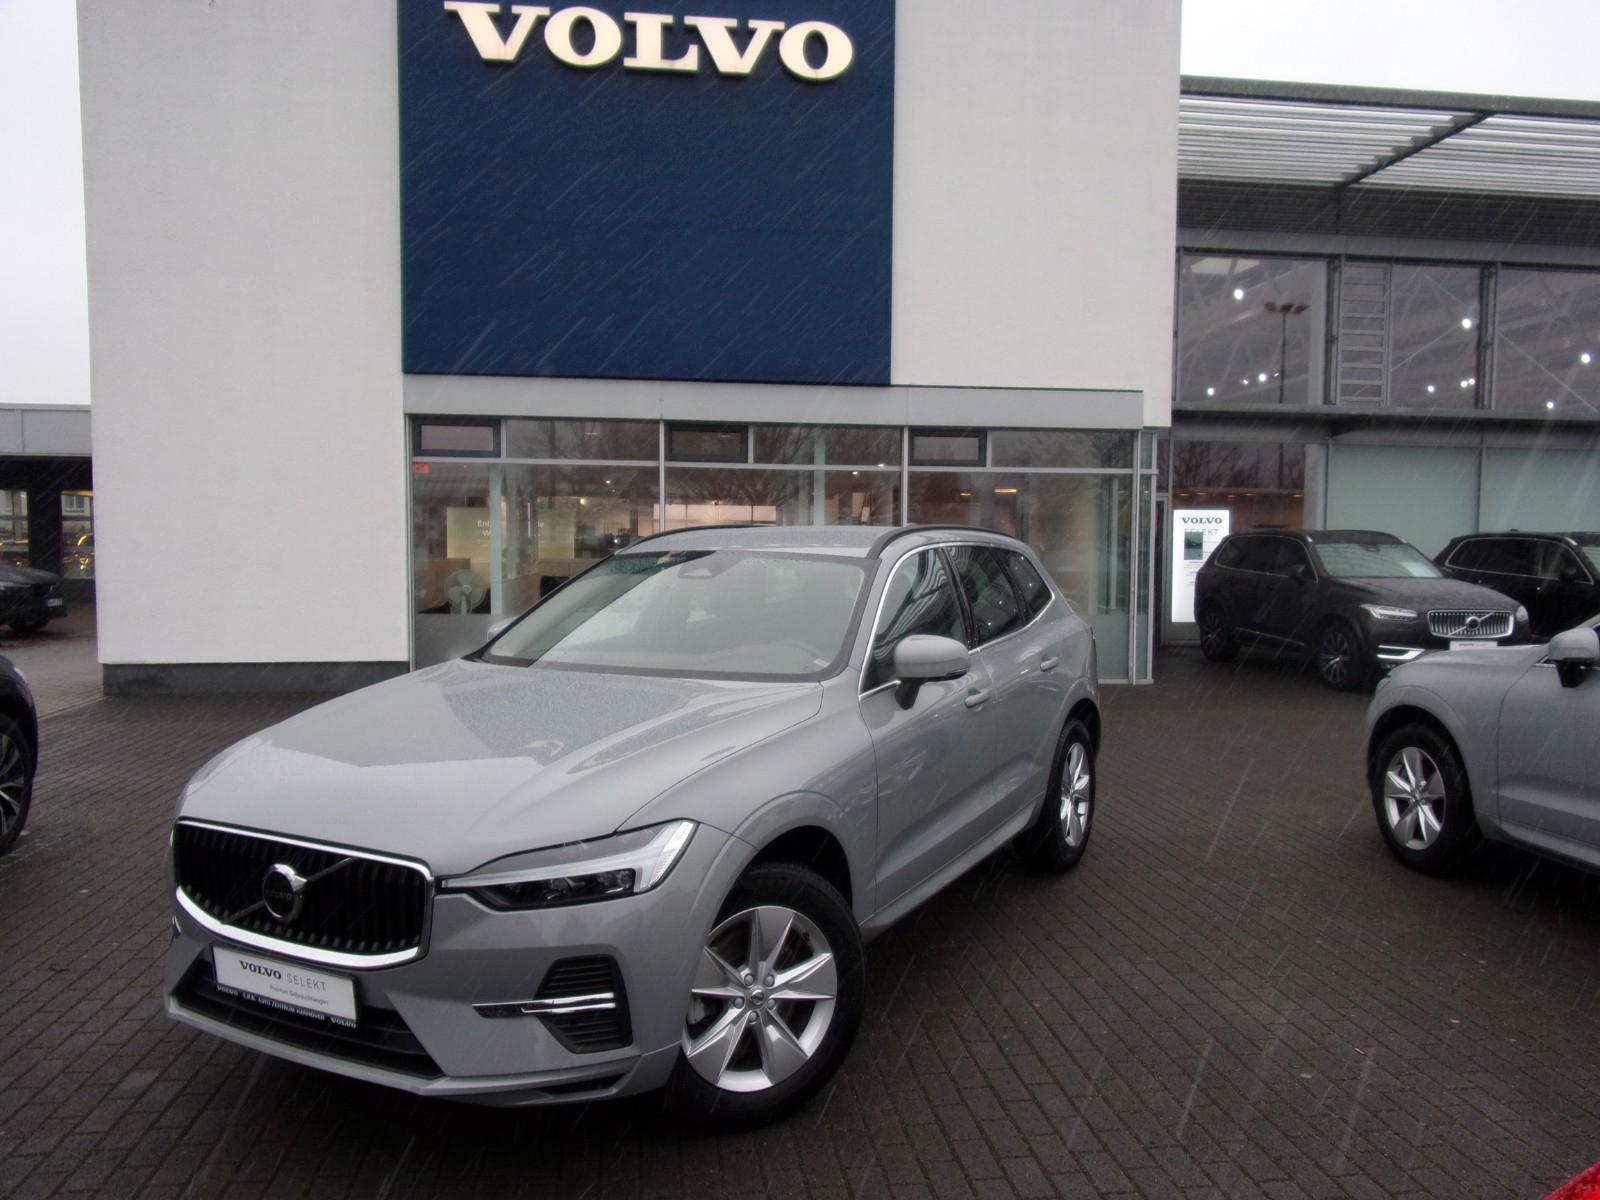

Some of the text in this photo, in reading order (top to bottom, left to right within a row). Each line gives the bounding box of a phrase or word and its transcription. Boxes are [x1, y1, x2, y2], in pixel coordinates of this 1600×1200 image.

[443, 1, 854, 80] VOLVO
[1181, 517, 1223, 525] VOLVO
[239, 960, 327, 991] VOLVO SELEKT
[216, 984, 239, 996] VOLVO
[330, 1016, 357, 1028] VOLVO
